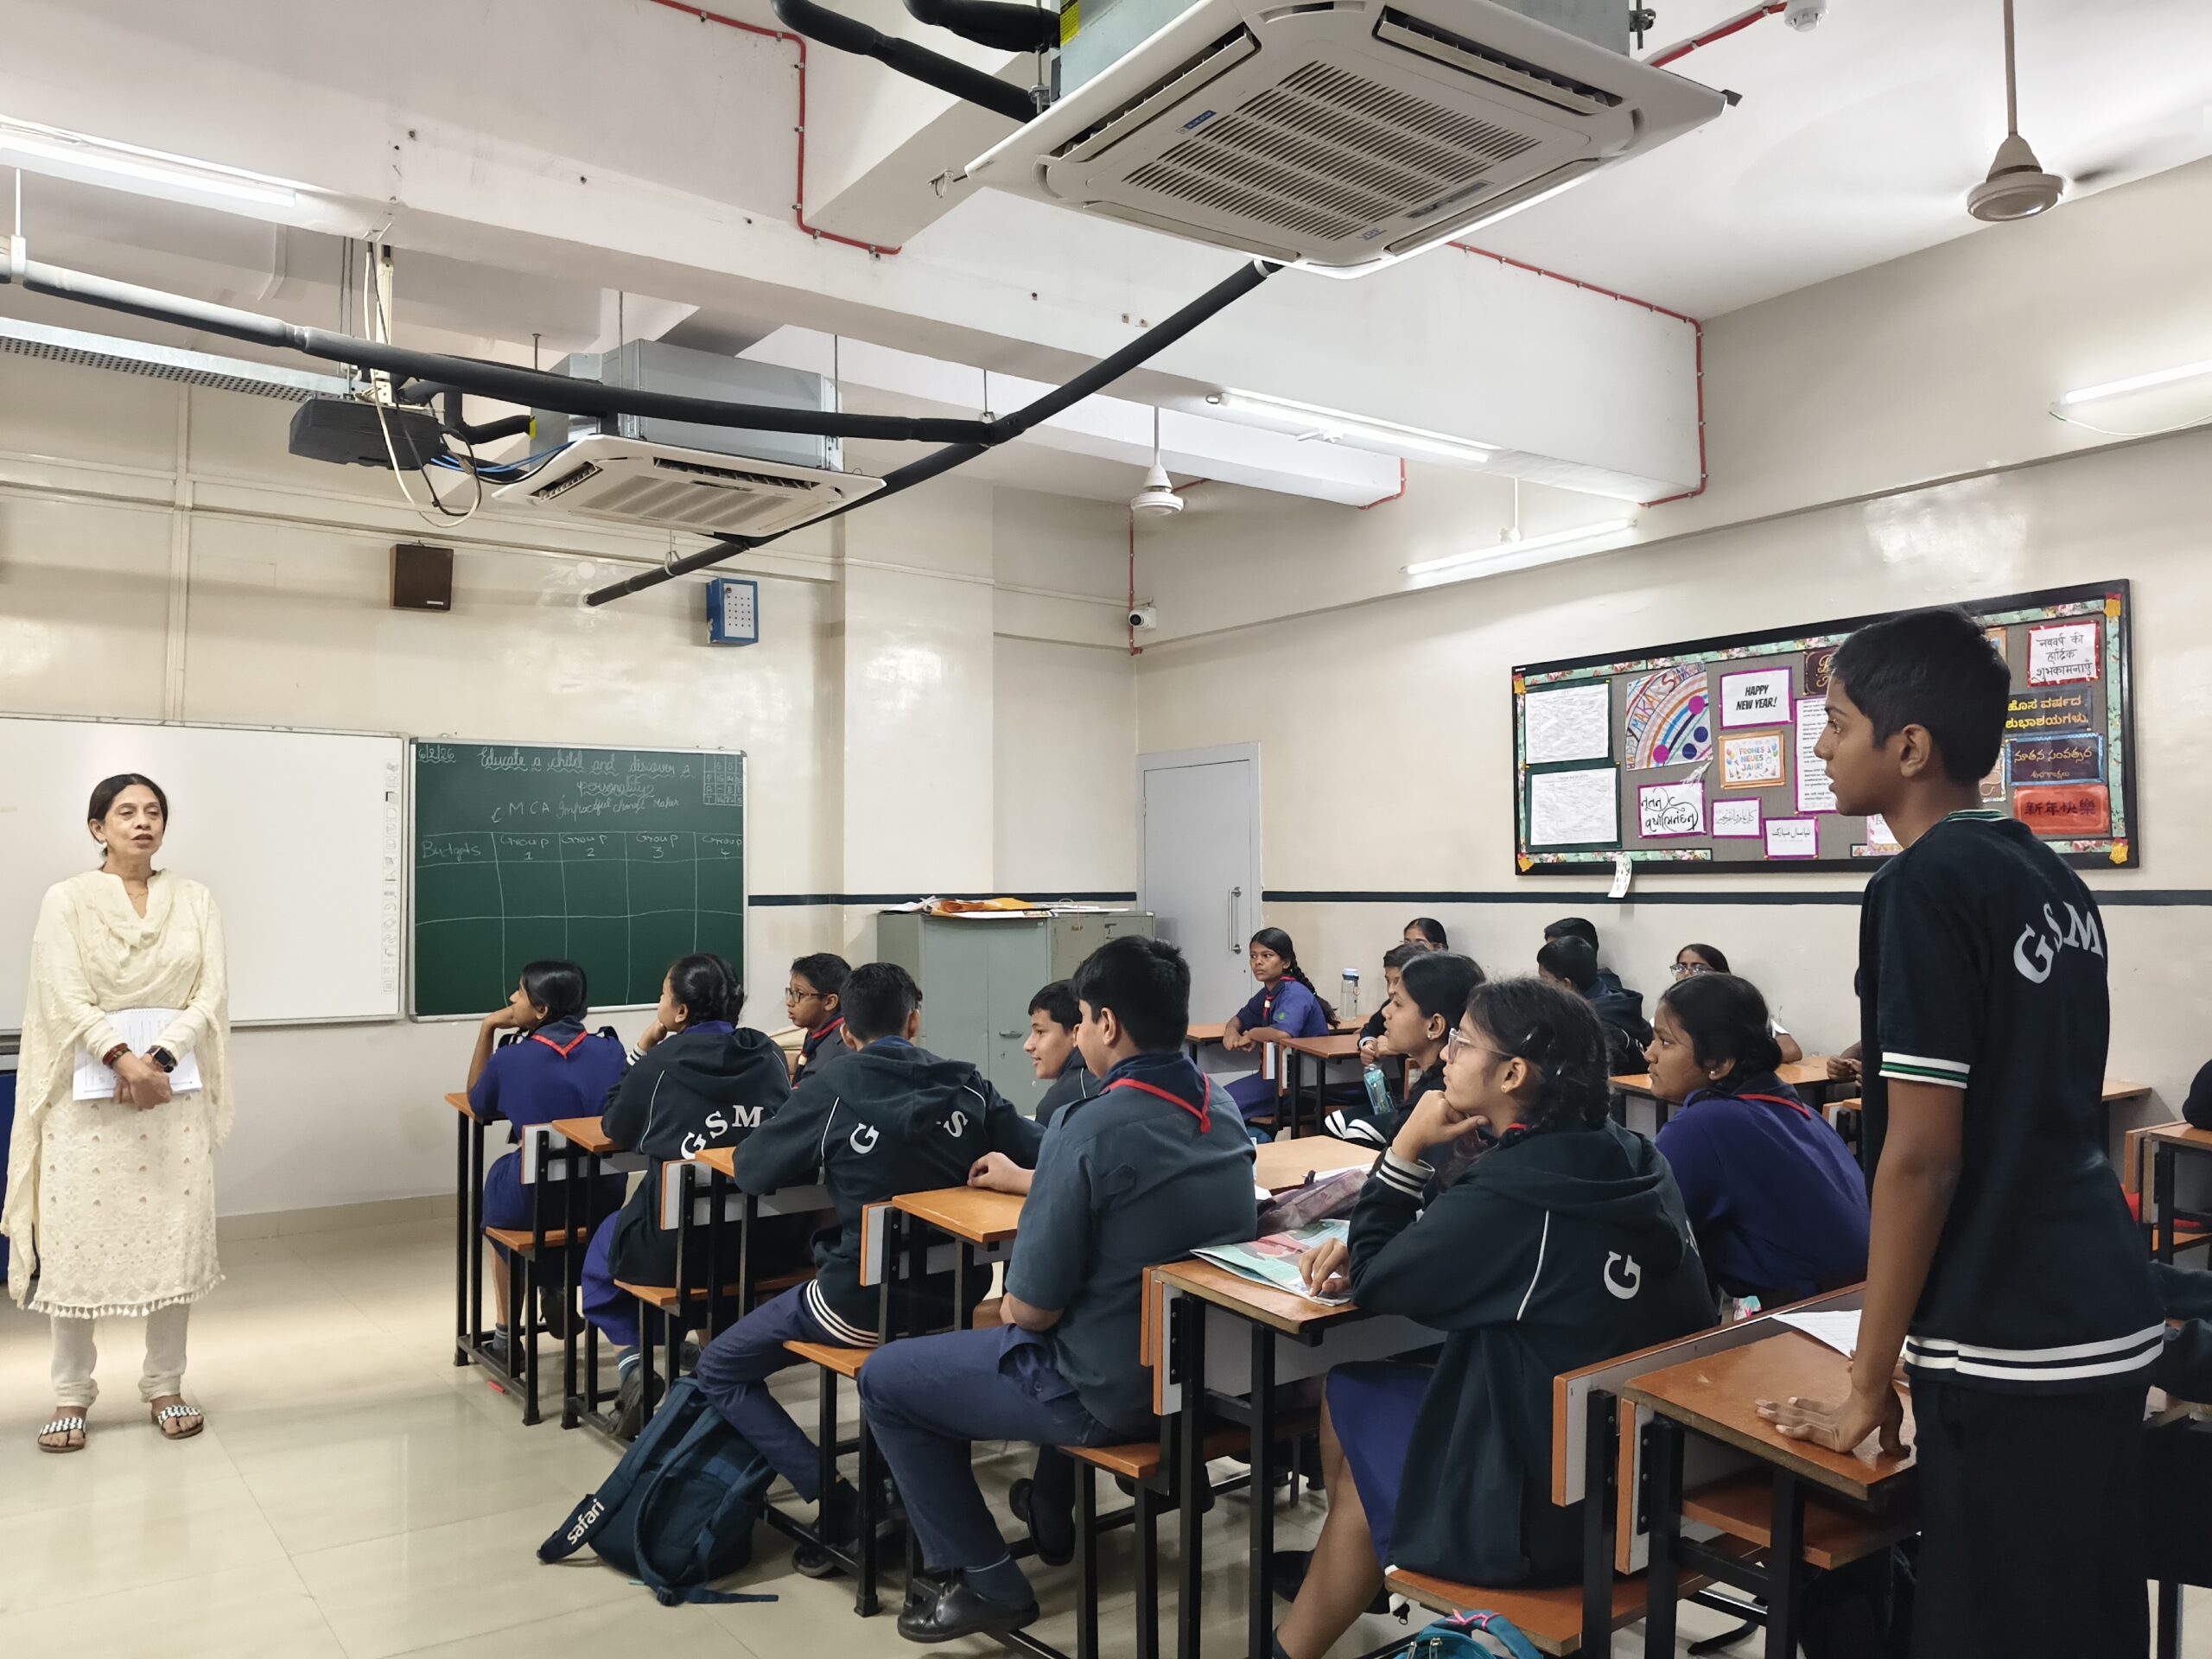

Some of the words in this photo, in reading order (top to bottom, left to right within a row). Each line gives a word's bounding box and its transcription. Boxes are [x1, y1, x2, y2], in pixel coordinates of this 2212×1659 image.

[2069, 632, 2085, 644] की
[1745, 684, 1770, 696] HAPPY
[1736, 700, 1753, 710] NEW
[1755, 696, 1777, 709] YEAR!
[2007, 698, 2037, 712] ಹೊಸ
[2040, 695, 2082, 709] ವರ್ಷದ
[477, 747, 526, 767] Educate
[548, 750, 582, 769] child
[593, 753, 615, 771] and
[2014, 749, 2045, 763] నూతన
[2024, 798, 2096, 816] 新年快樂
[500, 834, 550, 849] Group
[561, 833, 607, 845] Group
[636, 832, 679, 849] Group
[702, 835, 743, 847] Group
[524, 851, 533, 861] 1
[588, 847, 595, 857] 2
[652, 846, 664, 859] 3
[721, 847, 731, 860] 4
[2013, 900, 2104, 984] GSM
[1604, 1250, 1642, 1300] G
[567, 1497, 605, 1545] safari
